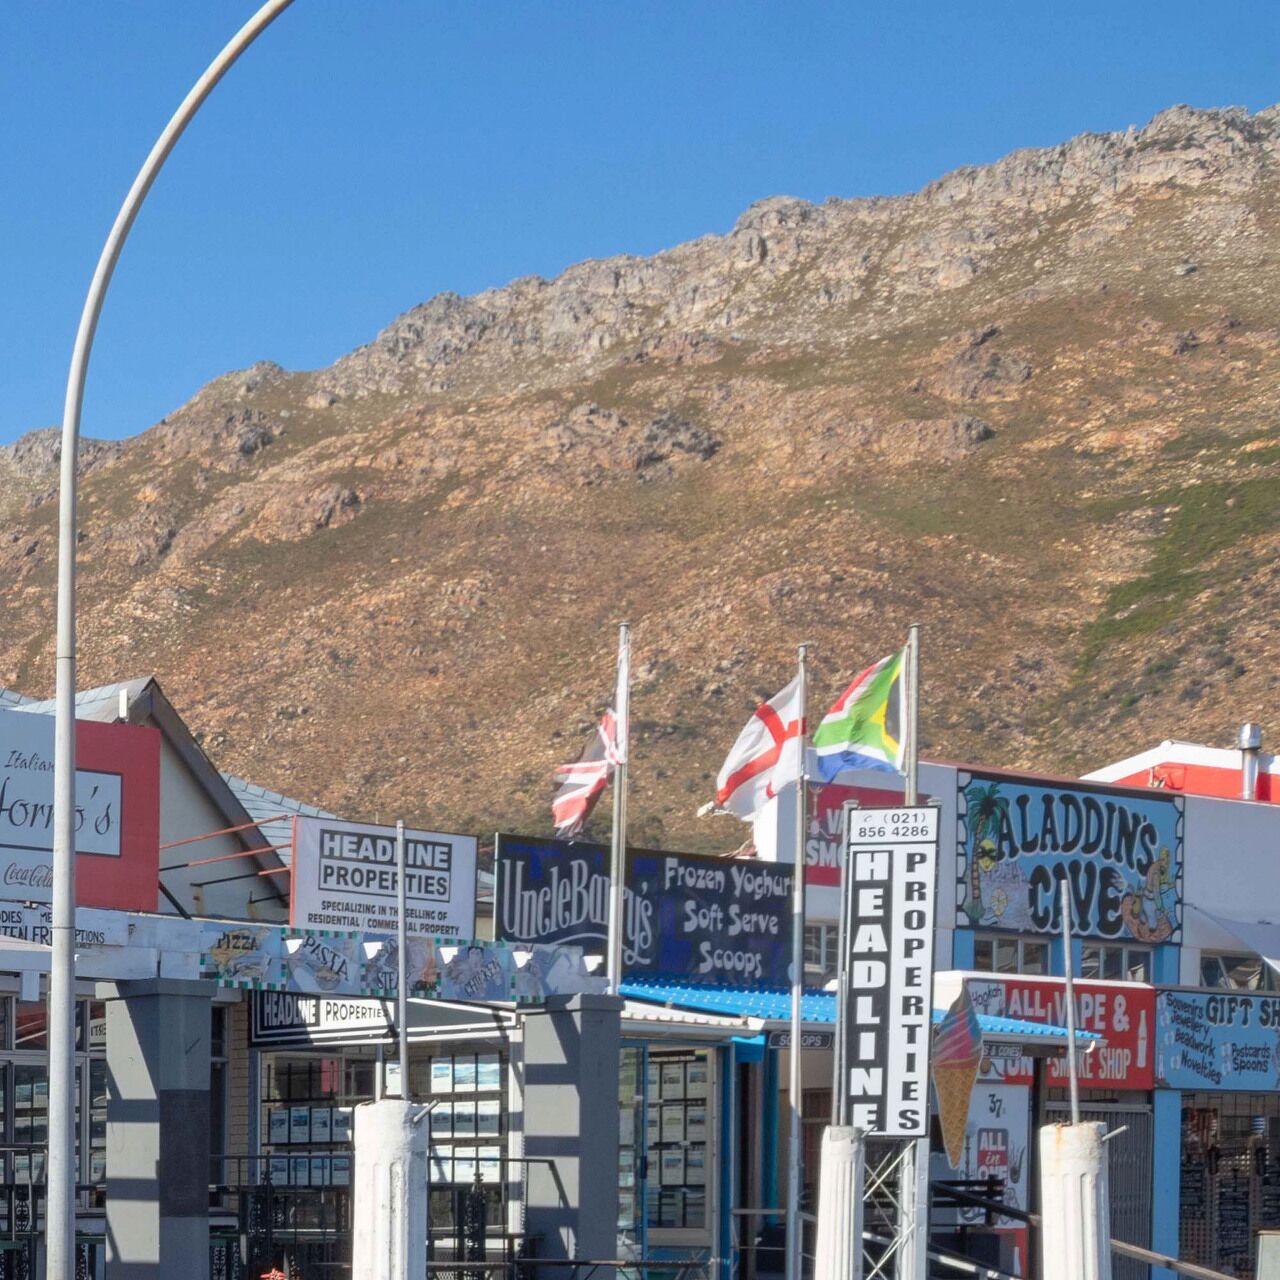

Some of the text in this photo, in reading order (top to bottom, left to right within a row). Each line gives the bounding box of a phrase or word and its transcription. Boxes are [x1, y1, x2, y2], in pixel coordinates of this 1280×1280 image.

[858, 825, 929, 838] 856 4286
[883, 812, 926, 825] (021)
[997, 793, 1158, 877] ALADDIN'S
[665, 857, 725, 893] Frozen
[321, 900, 376, 915] SPECIALIZING
[405, 910, 436, 920] SELLING
[1029, 859, 1125, 936] CAVE
[307, 912, 360, 928] RESIDENTIAL
[419, 923, 460, 936] PROPERTY
[683, 900, 779, 936] Soft Serve
[75, 930, 105, 944] PTIONS
[303, 935, 350, 983] PASTA
[698, 941, 762, 979] Scoops
[898, 852, 928, 1131] PROPERTIES
[263, 994, 317, 1027] HEADLINE
[1009, 988, 1046, 1017] ALL
[1113, 994, 1130, 1032] &
[1206, 995, 1253, 1027] GIFT
[1098, 1047, 1131, 1080] SHOP
[1232, 1056, 1269, 1077] Spoons
[979, 1131, 1006, 1151] ALL
